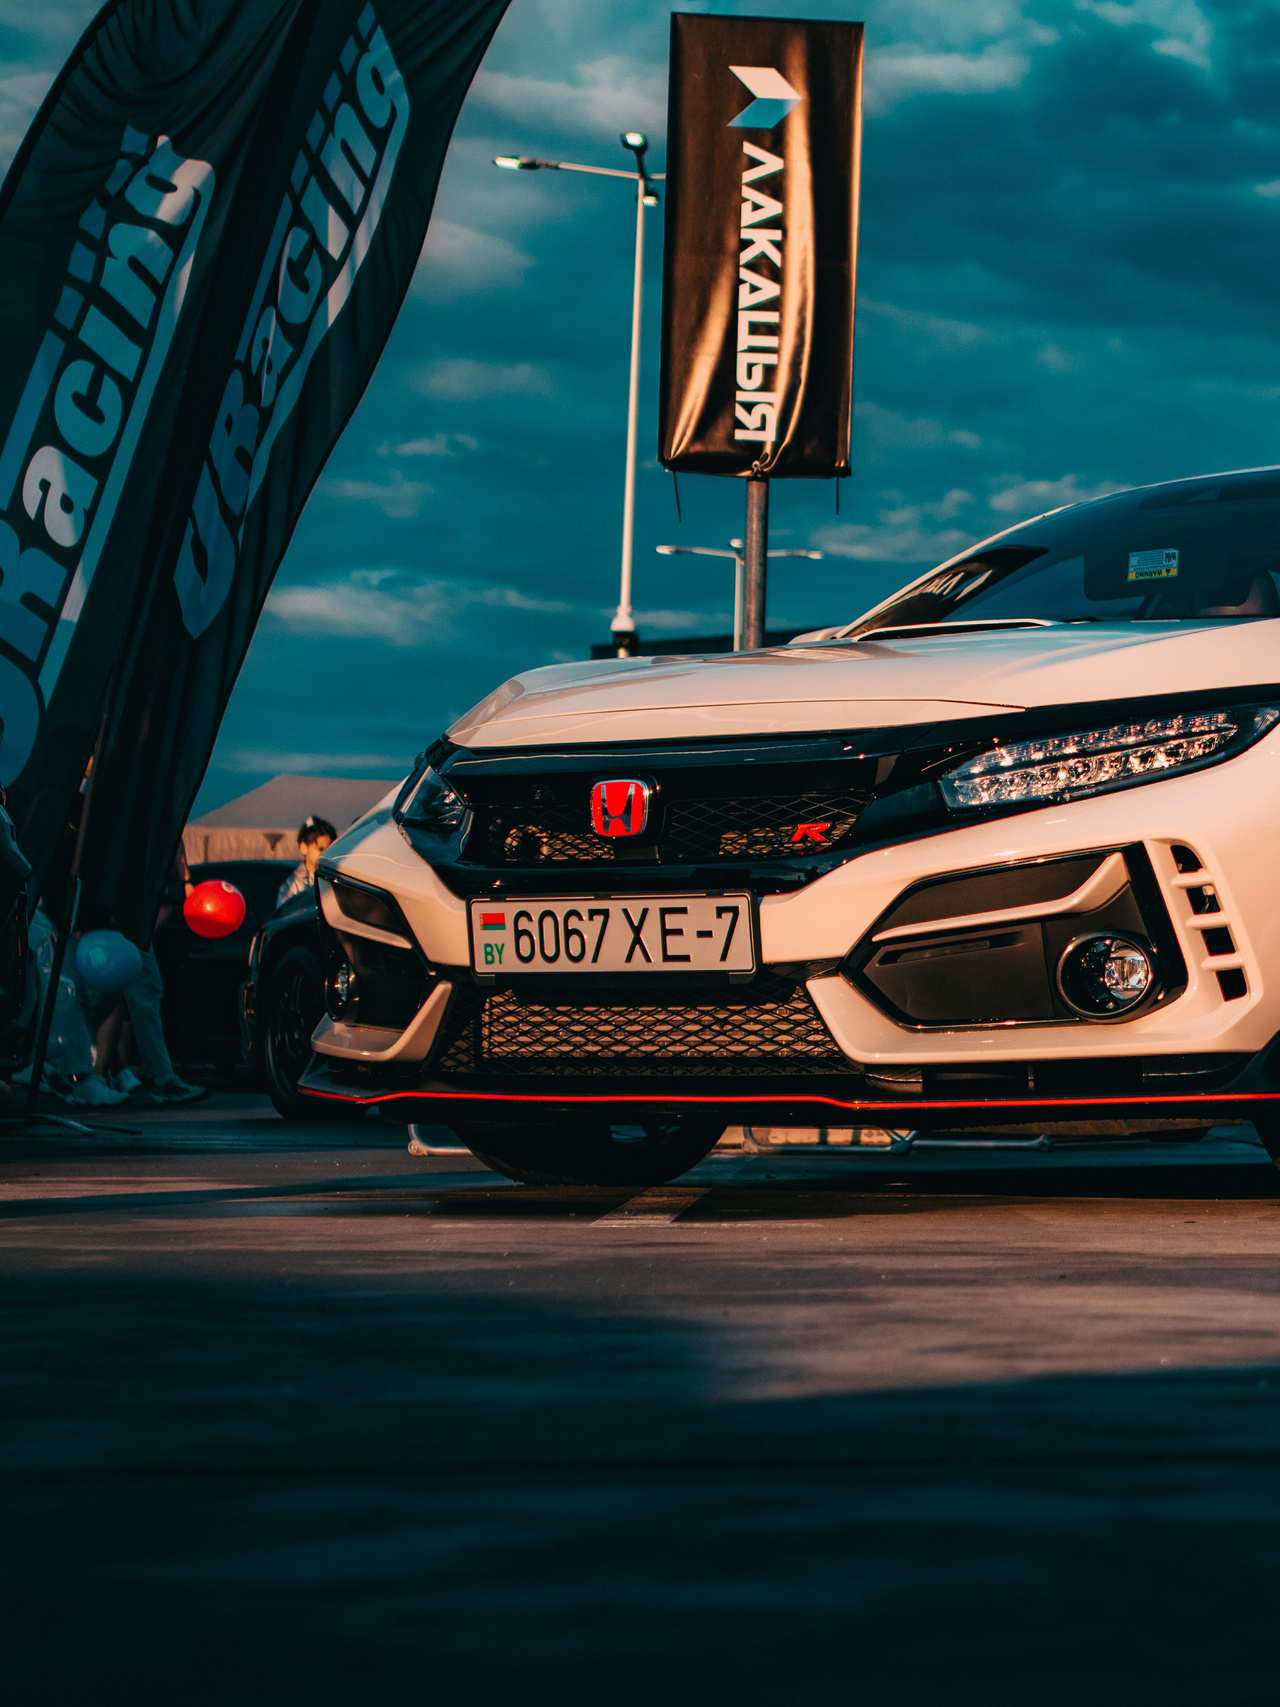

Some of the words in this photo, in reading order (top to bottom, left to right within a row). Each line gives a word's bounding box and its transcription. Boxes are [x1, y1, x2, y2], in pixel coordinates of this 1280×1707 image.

[734, 140, 784, 442] ЛАКАЦЫЯ
[483, 942, 505, 965] BY
[513, 907, 610, 964] 6067
[621, 905, 740, 963] XE-7
